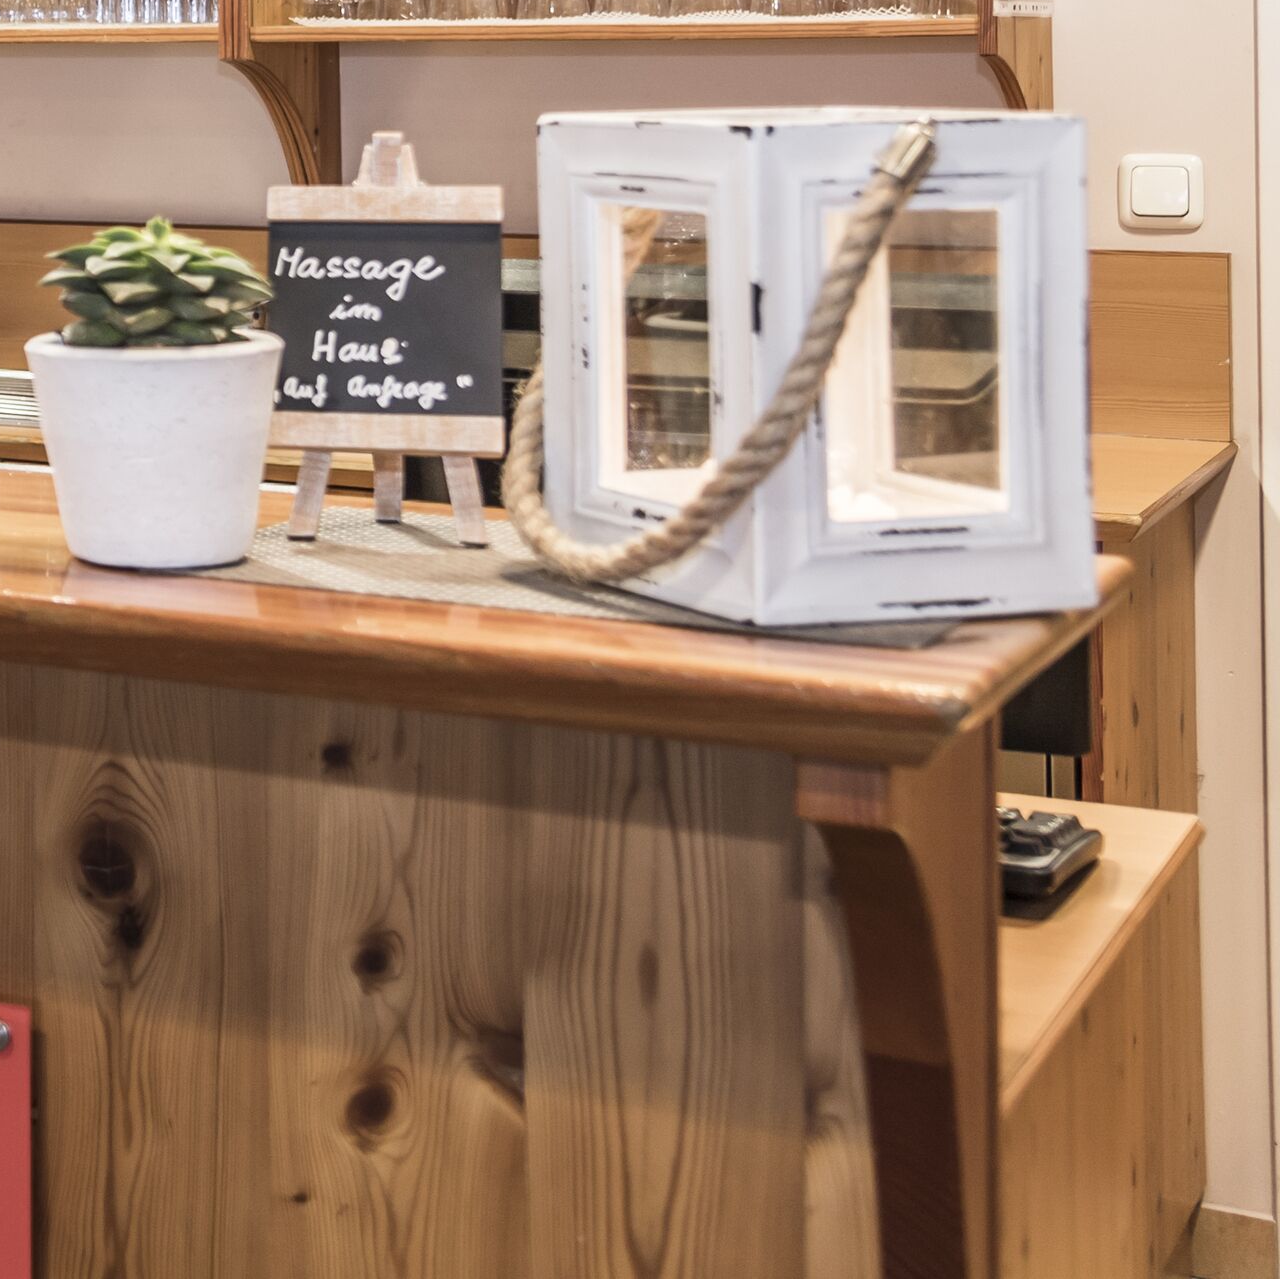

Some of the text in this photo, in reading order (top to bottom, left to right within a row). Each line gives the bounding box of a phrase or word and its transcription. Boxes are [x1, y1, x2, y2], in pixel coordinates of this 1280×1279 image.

[274, 246, 445, 301] Massage
[328, 293, 383, 322] im
[311, 328, 406, 365] Haus
